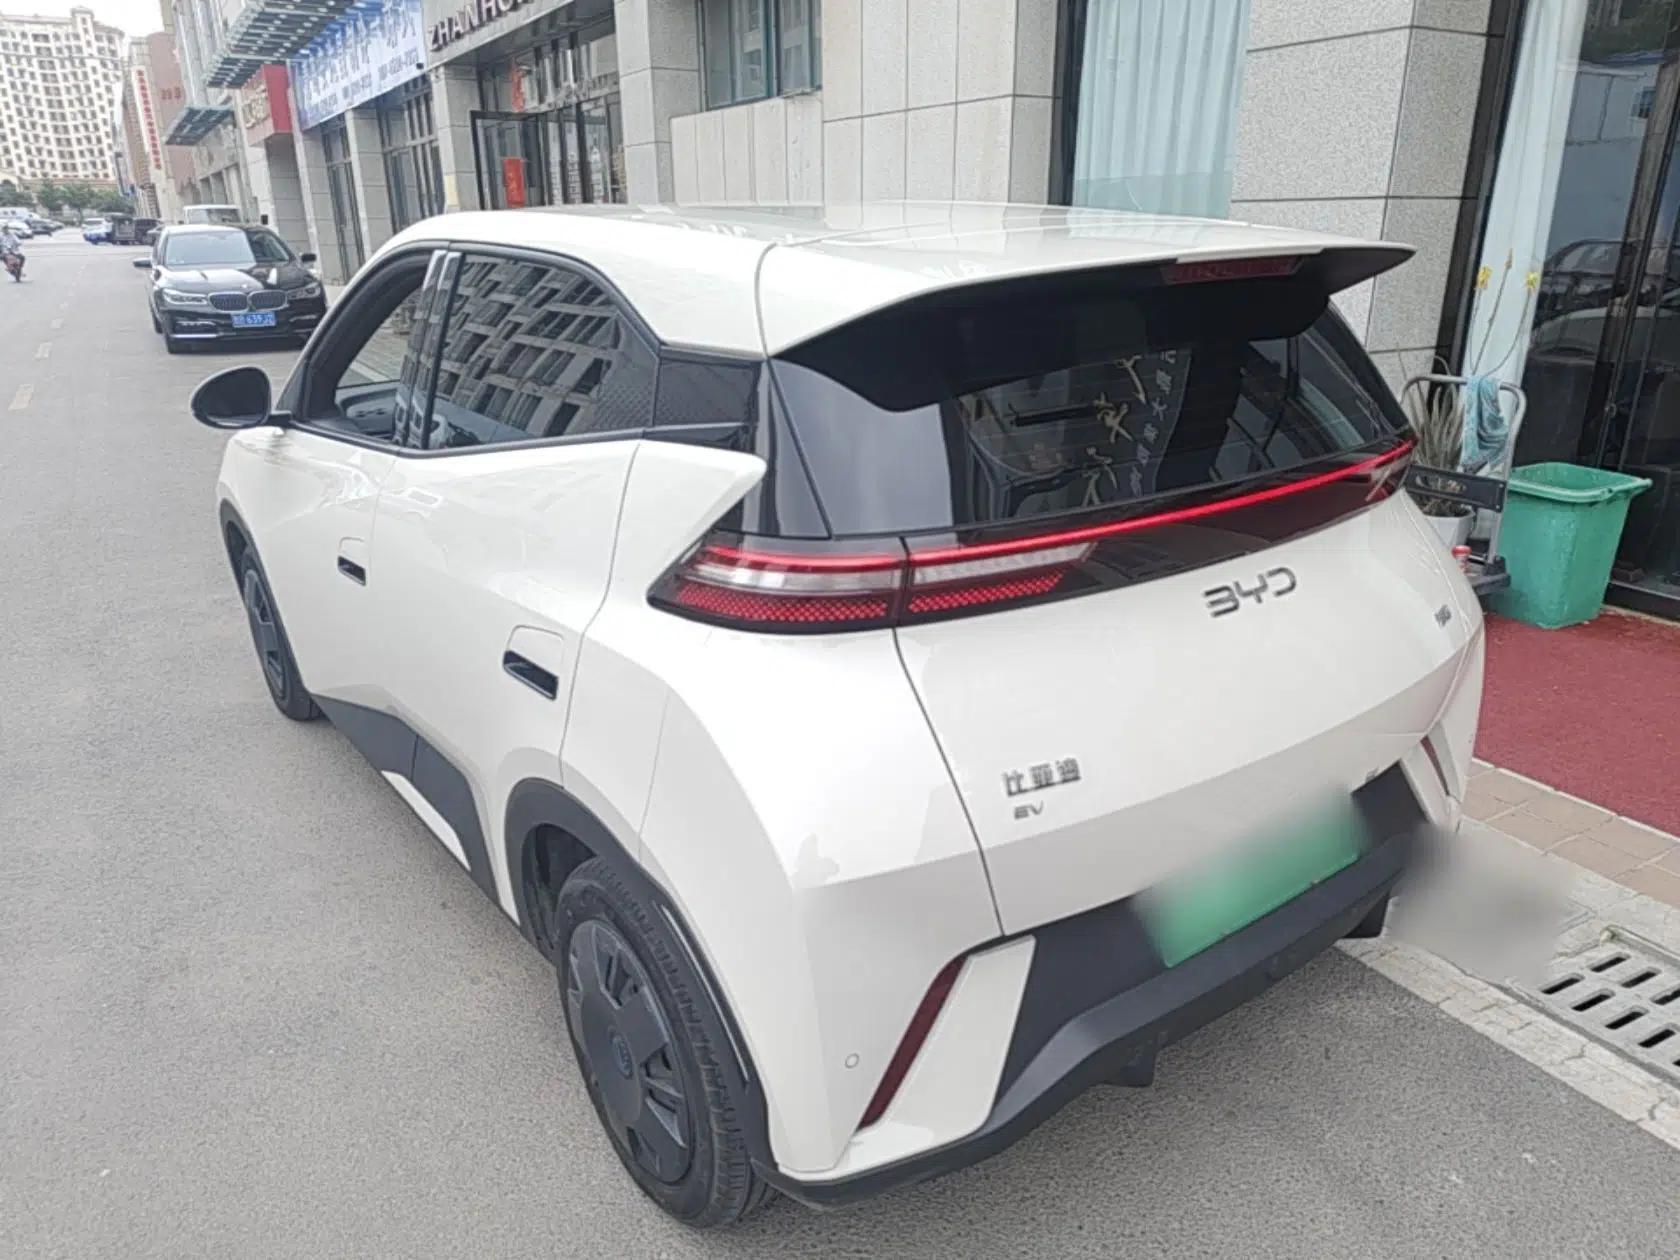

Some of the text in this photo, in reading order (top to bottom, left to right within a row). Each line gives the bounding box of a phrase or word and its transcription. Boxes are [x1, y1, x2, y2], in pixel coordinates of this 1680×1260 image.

[1203, 567, 1297, 618] BYD
[1001, 757, 1081, 797] 比亚迪
[1013, 799, 1044, 819] EV
